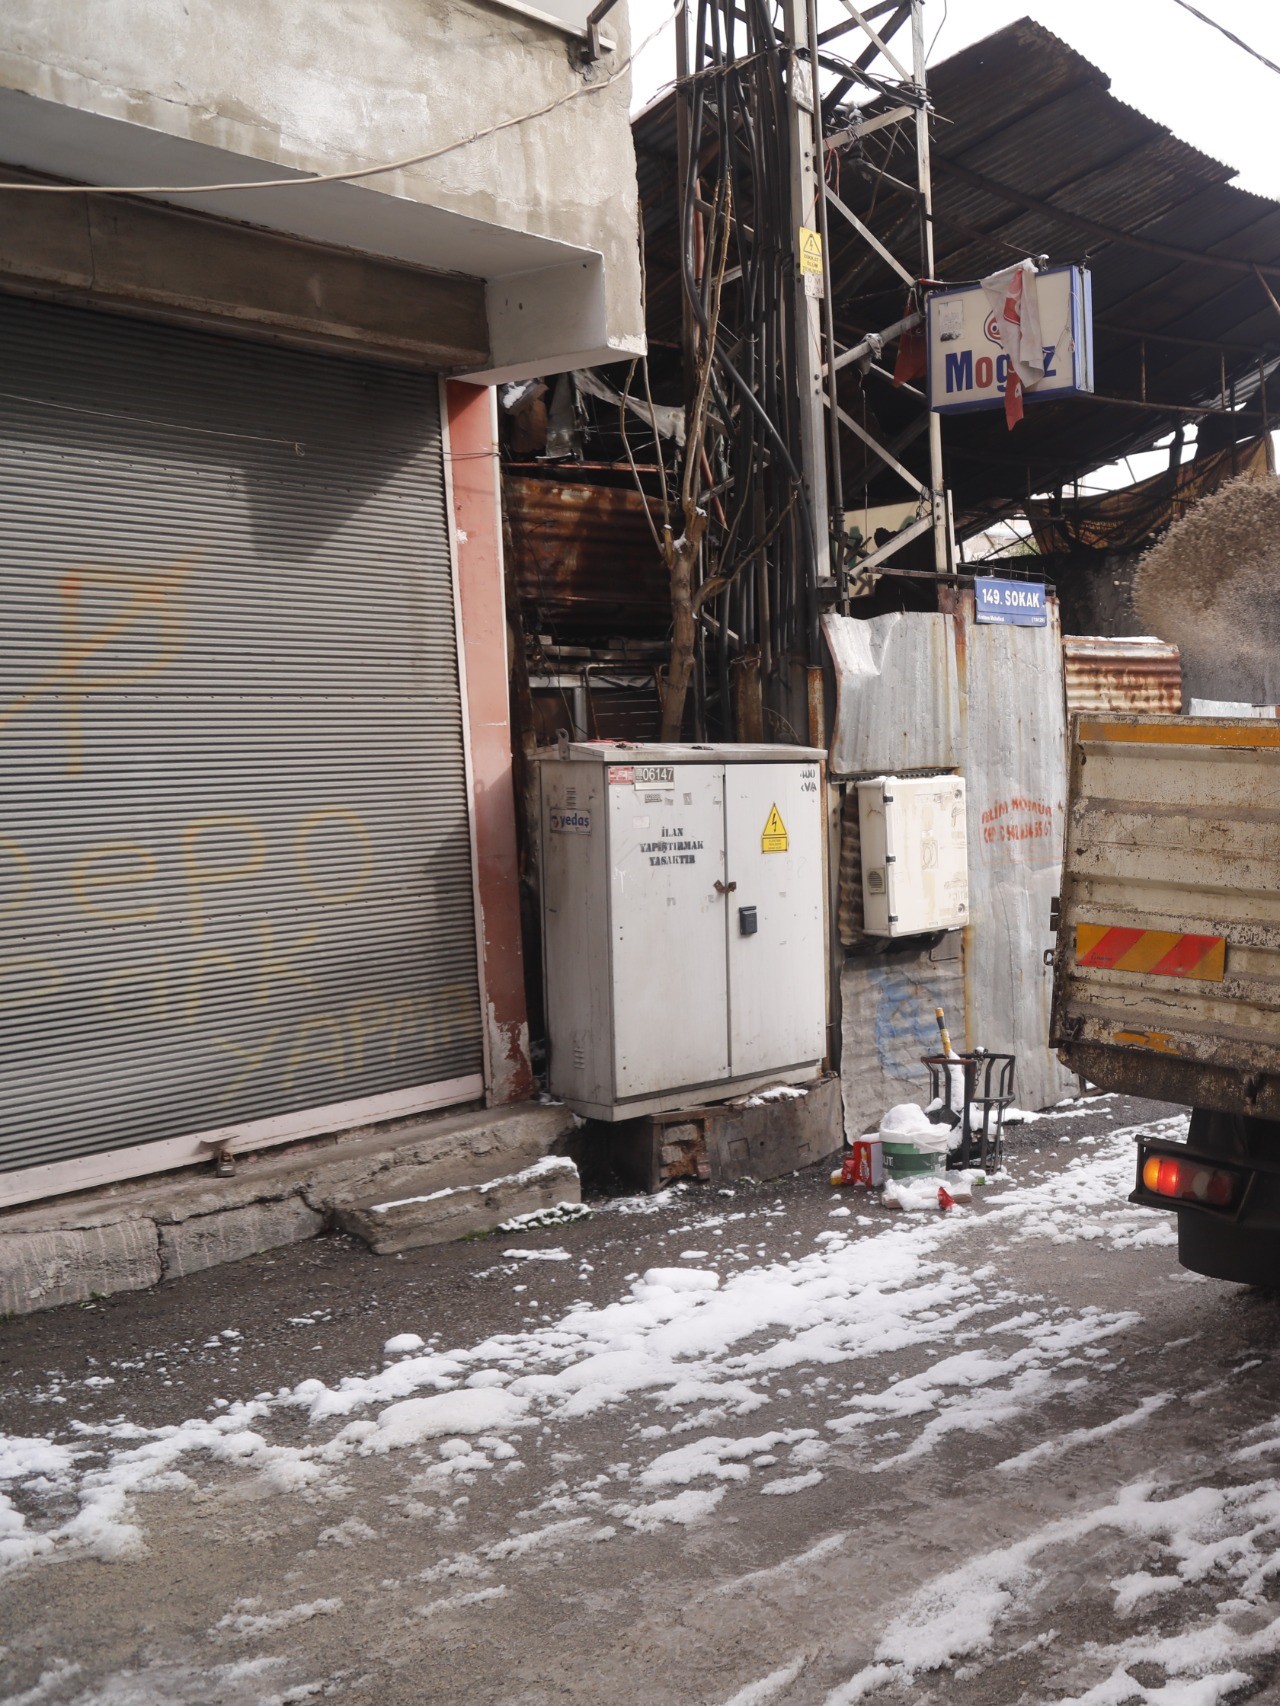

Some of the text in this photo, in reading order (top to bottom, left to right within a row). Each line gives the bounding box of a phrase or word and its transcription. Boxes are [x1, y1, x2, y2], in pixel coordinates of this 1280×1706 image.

[945, 345, 1057, 393] Mogz
[982, 588, 1040, 608] 149. SOKAK
[642, 767, 674, 781] 06147
[560, 812, 589, 828] yedaş
[661, 826, 684, 838] İLAN
[649, 854, 696, 867] YASAKTIR
